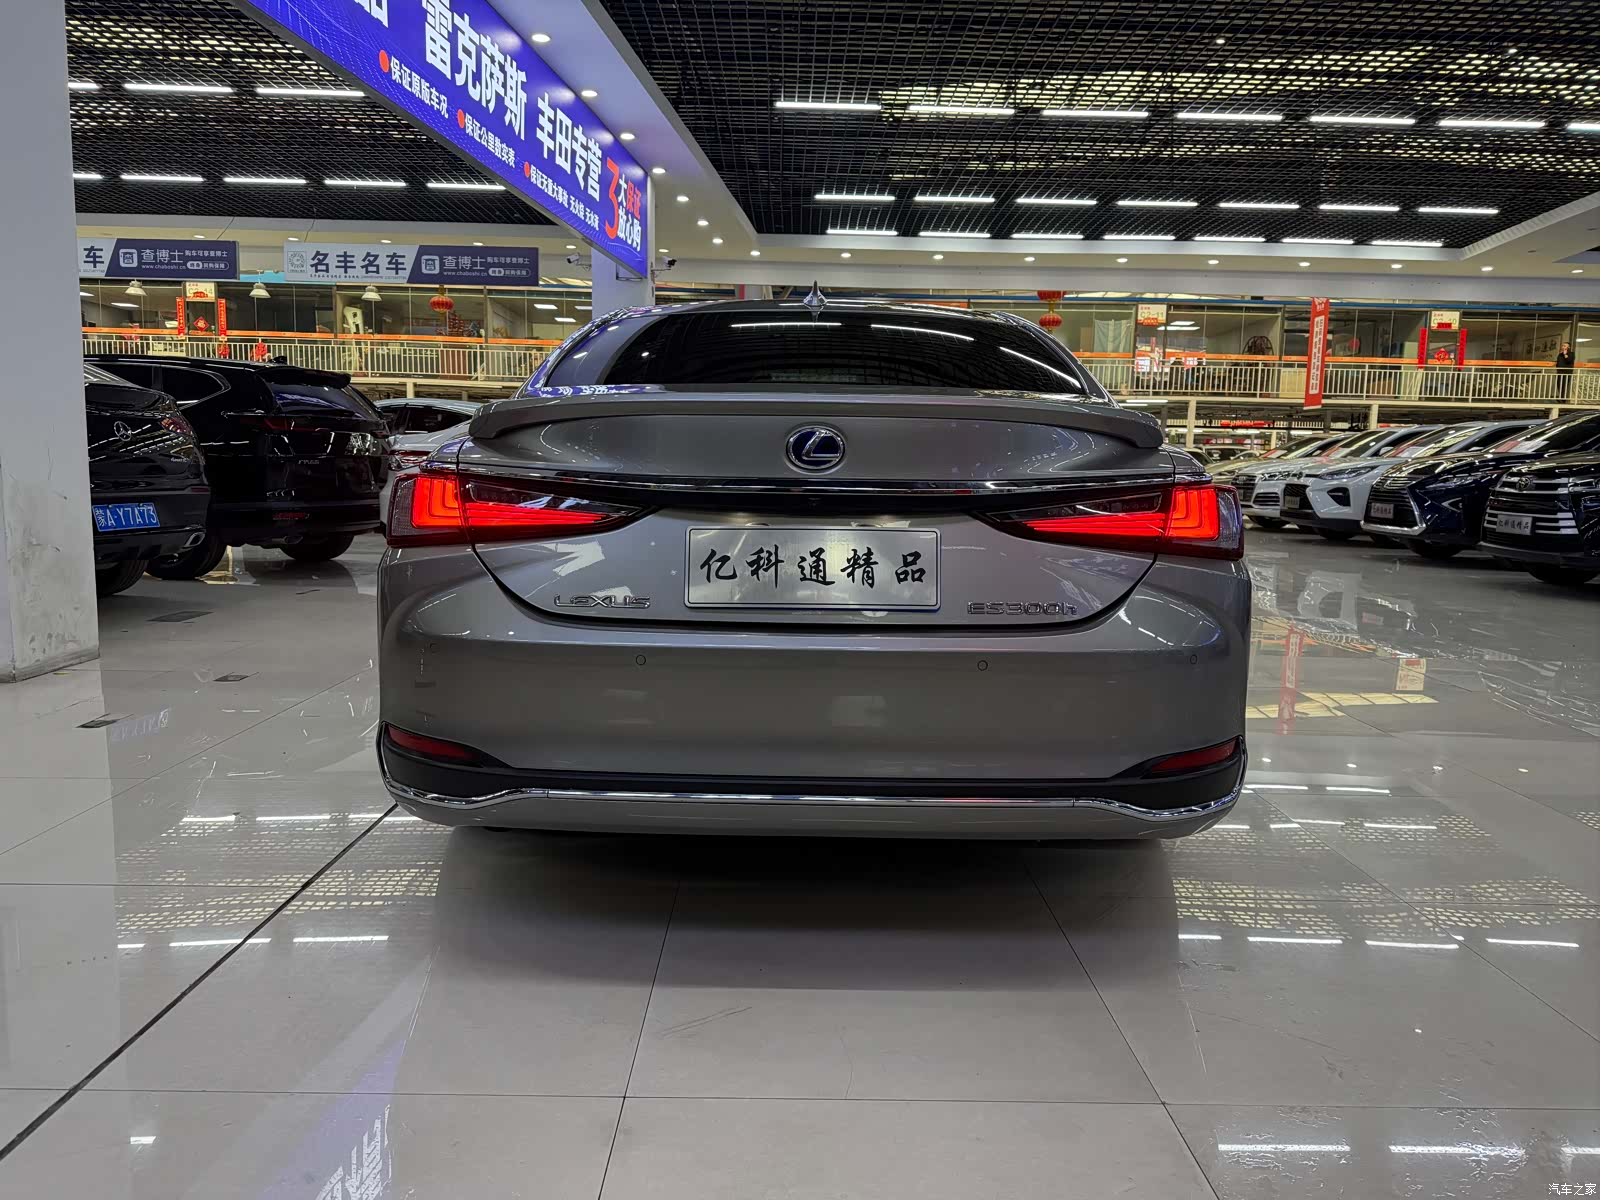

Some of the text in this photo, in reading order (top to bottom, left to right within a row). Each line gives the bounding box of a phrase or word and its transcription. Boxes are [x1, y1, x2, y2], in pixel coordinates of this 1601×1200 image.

[390, 55, 449, 119] 保证原版车况
[465, 113, 516, 168] 保证公里数实表
[422, 0, 602, 202] 雷克萨斯 丰田专营
[605, 157, 619, 239] 3
[617, 206, 642, 251] 放心购
[83, 246, 104, 268] 车
[141, 249, 184, 264] 查博士
[310, 250, 407, 275] 名丰名车
[443, 255, 486, 270] 查博士
[700, 544, 927, 589] 亿科通精品
[554, 594, 650, 609] LEXUS
[967, 601, 1078, 616] ES300h
